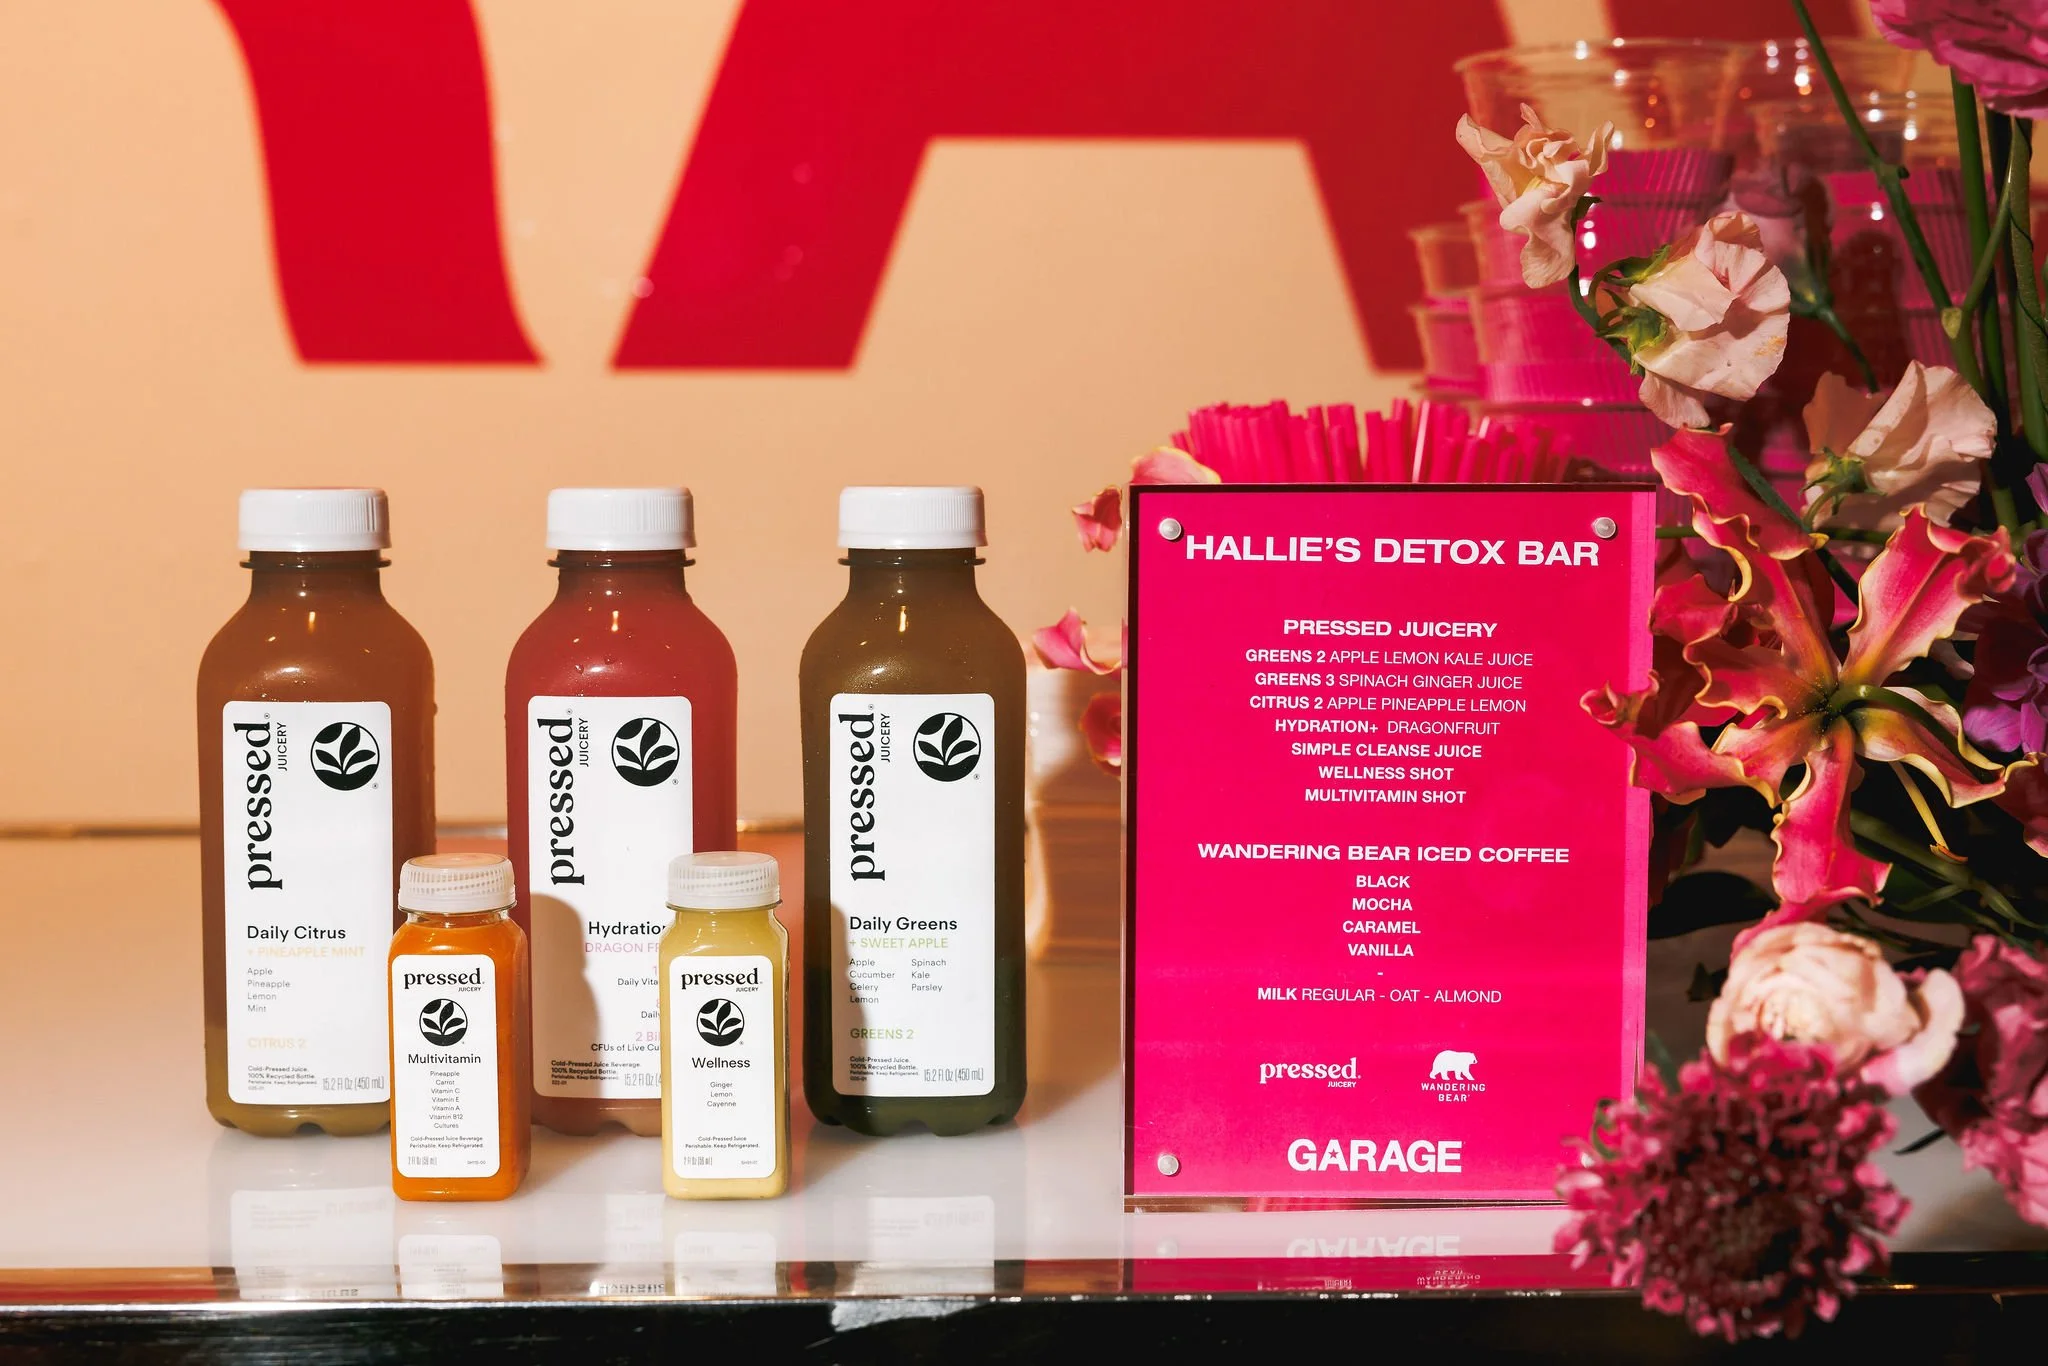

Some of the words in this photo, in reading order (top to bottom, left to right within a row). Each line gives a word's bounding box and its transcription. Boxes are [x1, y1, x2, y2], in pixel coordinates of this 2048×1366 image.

[1186, 535, 1360, 563] HALLIE’S
[1374, 538, 1505, 565] DETOX
[1518, 541, 1599, 566] BAR
[1284, 620, 1391, 636] PRESSED
[1399, 621, 1497, 638] JUICERY
[1246, 649, 1312, 663] GREENS
[1317, 650, 1326, 663] 2
[1330, 651, 1379, 664] APPLE
[1384, 652, 1439, 665] LEMON
[1444, 652, 1482, 665] KALE
[1488, 653, 1533, 666] JUICE
[1255, 673, 1321, 687] GREENS
[1326, 674, 1334, 687] 3
[1339, 674, 1408, 688] SPINACH
[1413, 675, 1472, 689] GINGER
[1477, 676, 1522, 689] JUICE
[1250, 696, 1309, 709] CITRUS
[1314, 696, 1323, 709] 2
[1327, 698, 1376, 710] APPLE
[1382, 698, 1465, 712] PINEAPPLE
[1470, 699, 1526, 712] LEMON
[1275, 720, 1378, 734] HYDRATION+
[1388, 721, 1500, 735] DRAGONFRUIT
[579, 718, 589, 767] JUICERY
[881, 713, 890, 762] JUICERY
[277, 722, 287, 771] JUICERY
[1292, 743, 1351, 756] SIMPLE
[1356, 744, 1430, 757] CLEANSE
[1434, 744, 1482, 758] JUICE
[1319, 766, 1405, 780] WELLNESS
[1410, 767, 1454, 780] SHOT
[537, 717, 585, 885] pressed
[838, 713, 885, 881] pressed
[1305, 789, 1417, 803] MULTIVITAMIN
[1422, 790, 1466, 804] SHOT
[233, 722, 282, 890] pressed
[1198, 843, 1340, 861] WANDERING
[1348, 845, 1410, 861] BEAR
[1417, 846, 1472, 862] ICED
[1479, 847, 1569, 863] COFFEE
[1356, 875, 1411, 888] BLACK
[1352, 897, 1412, 912] MOCHA
[589, 921, 665, 938] Hydratio
[850, 917, 891, 933] Daily
[897, 917, 958, 930] Greens
[1342, 920, 1421, 934] CARAMEL
[247, 925, 289, 942] Daily
[294, 925, 346, 939] Citrus
[585, 943, 643, 952] DRAGON
[860, 938, 904, 948] SWEET
[908, 938, 948, 948] APPLE
[1348, 943, 1414, 957] VANILLA
[258, 947, 328, 958] PINEAPPLE
[332, 947, 365, 957] MINT
[850, 959, 875, 967] Apple
[911, 959, 946, 968] Spinach
[248, 968, 273, 976] Apple
[404, 968, 481, 989] pressed
[681, 968, 759, 989] pressed
[850, 971, 895, 979] Cucumber
[911, 971, 930, 979] Kale
[248, 980, 290, 988] Pineapple
[618, 978, 639, 986] Daily
[850, 983, 878, 992] Celery
[911, 984, 942, 992] Parsley
[248, 992, 277, 1000] Lemon
[1258, 987, 1297, 1001] MILK
[1302, 988, 1375, 1001] REGULAR
[1390, 989, 1420, 1002] OAT
[1434, 990, 1502, 1003] ALMOND
[636, 1032, 642, 1041] 2
[850, 1029, 903, 1039] GREENS
[907, 1029, 913, 1039] 2
[248, 1038, 296, 1048] CITRUS
[298, 1038, 306, 1048] 2
[408, 1054, 481, 1063] Multivitamin
[692, 1057, 751, 1068] Wellness
[924, 1069, 936, 1081] 15.2
[955, 1068, 970, 1082] (450
[1260, 1057, 1357, 1084] pressed
[625, 1074, 637, 1086] 15.2
[646, 1074, 654, 1086] Oz
[1421, 1083, 1486, 1092] WANDERING
[1438, 1094, 1467, 1102] BEAR
[1287, 1139, 1463, 1174] GARAGE
